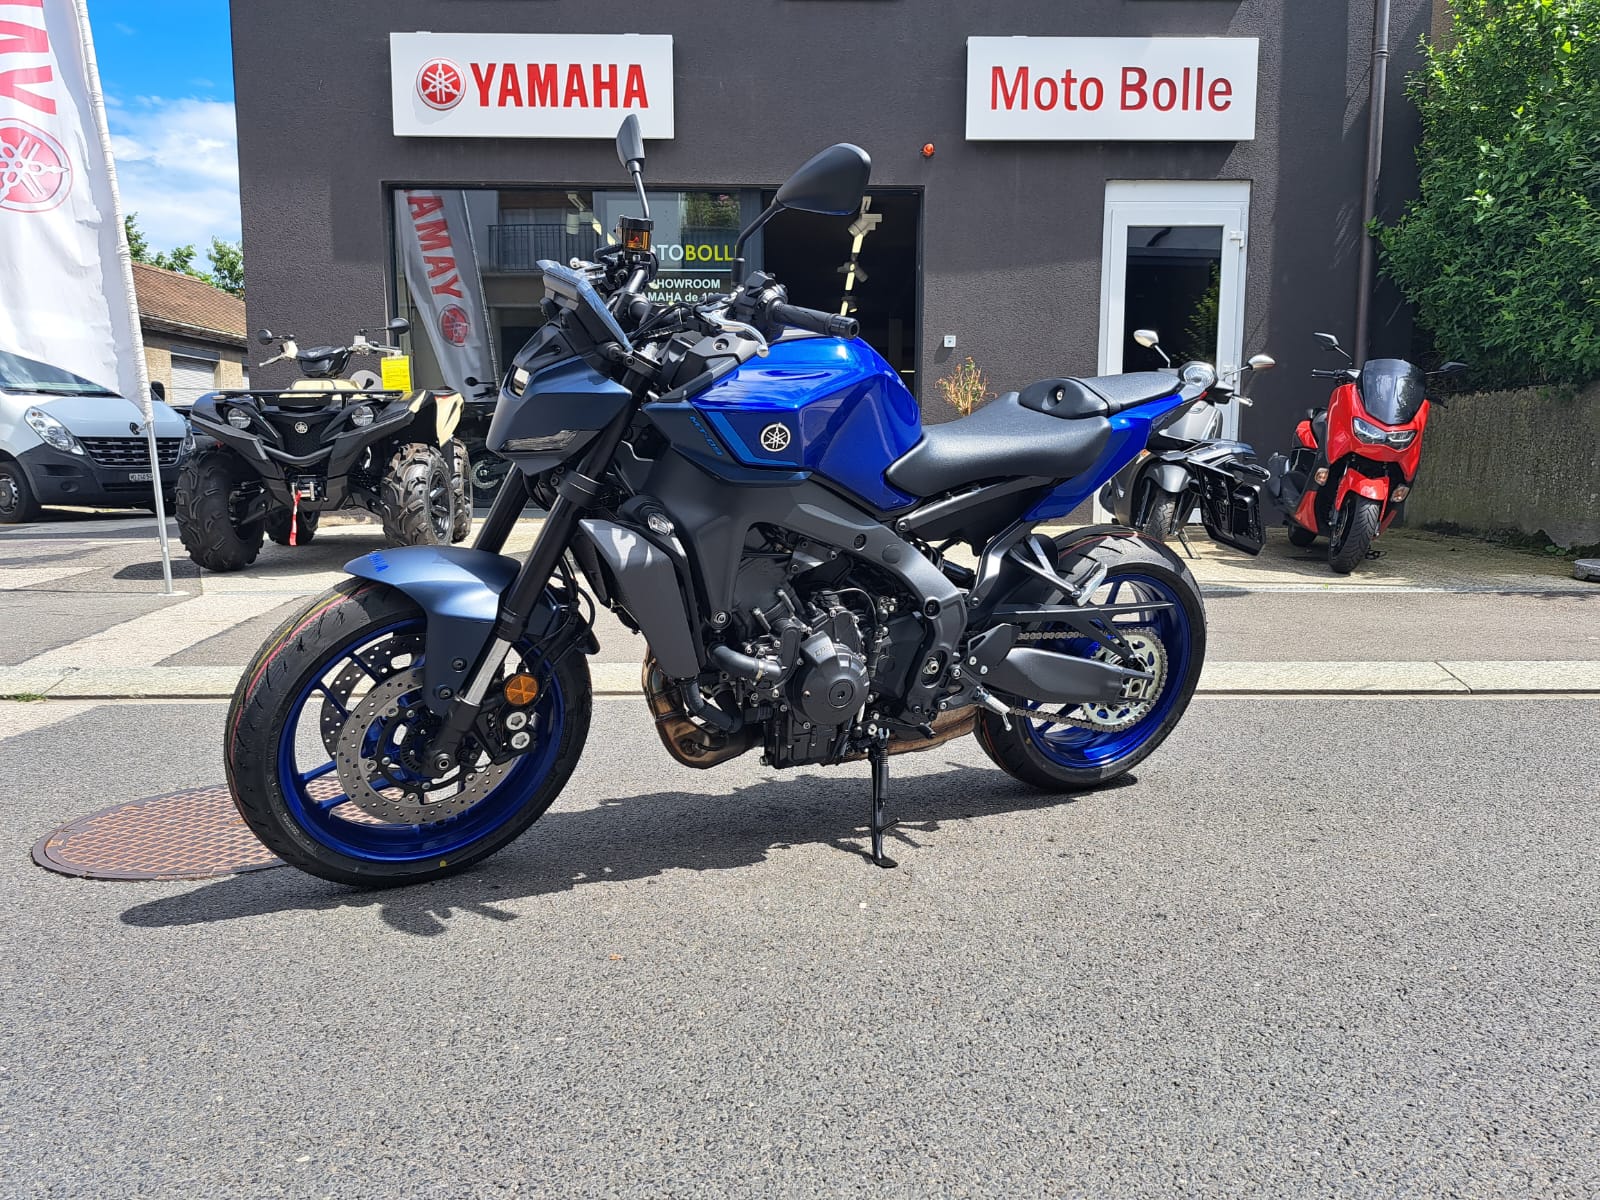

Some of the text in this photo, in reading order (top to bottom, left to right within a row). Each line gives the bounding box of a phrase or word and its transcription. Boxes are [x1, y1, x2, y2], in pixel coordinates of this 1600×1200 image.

[470, 63, 649, 108] YAMAHA
[990, 66, 1233, 111] Moto Bolle
[650, 278, 720, 289] HOWROOM
[685, 292, 698, 302] de
